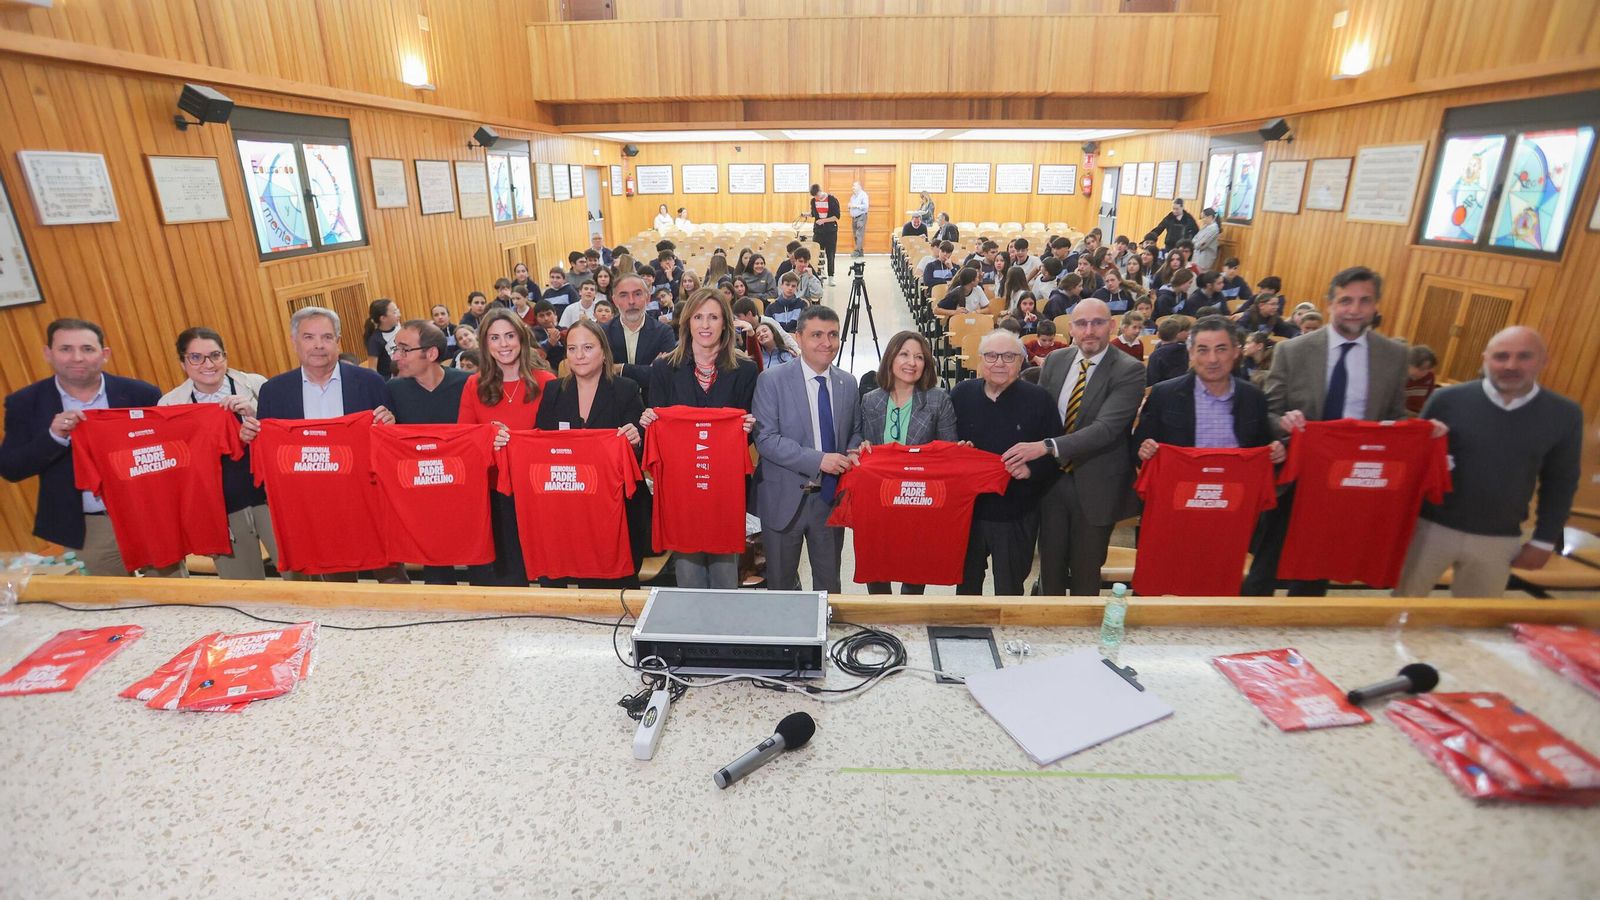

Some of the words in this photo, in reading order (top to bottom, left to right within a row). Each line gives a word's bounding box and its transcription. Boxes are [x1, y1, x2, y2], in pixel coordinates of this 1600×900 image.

[133, 445, 163, 456] MEMORIAL
[301, 446, 330, 454] MEMORIAL
[134, 451, 165, 466] PADRE
[302, 453, 330, 463] PADRE
[417, 459, 443, 467] MEMORIAL
[129, 458, 177, 477] MARCELINO
[294, 462, 339, 472] MARCELINO
[419, 466, 444, 476] PADRE
[413, 474, 454, 485] MARCELINO
[550, 472, 577, 482] PADRE
[544, 482, 585, 491] MARCELINO
[900, 487, 926, 497] PADRE
[893, 496, 933, 506] MARCELINO
